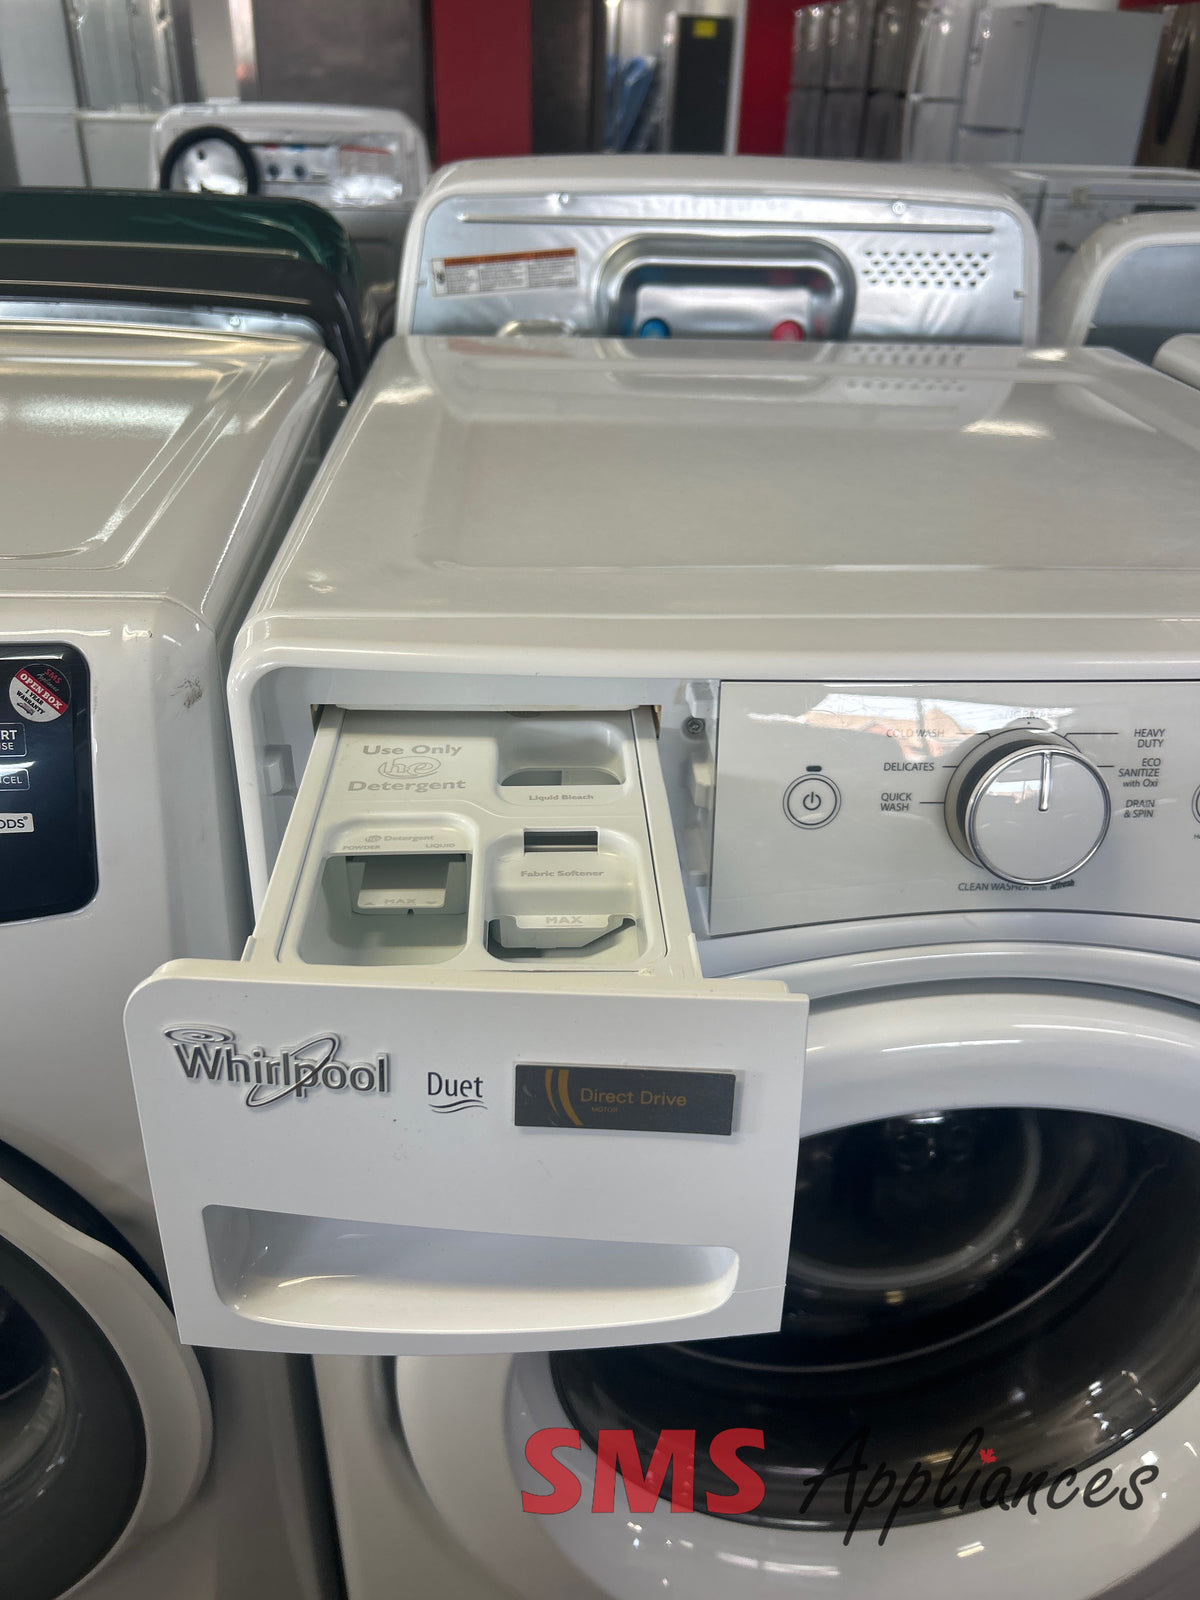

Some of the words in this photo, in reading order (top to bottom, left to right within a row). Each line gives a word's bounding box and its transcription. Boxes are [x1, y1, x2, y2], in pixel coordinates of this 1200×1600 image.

[20, 673, 44, 694] OPEN
[42, 691, 63, 710] BOX
[16, 690, 46, 715] WARRANTY
[30, 693, 44, 706] YEAR
[886, 728, 913, 738] COLD
[917, 728, 945, 738] WASH
[1134, 728, 1165, 738] HEAVY
[0, 742, 15, 751] SE
[1137, 739, 1164, 748] DUTY
[362, 744, 404, 755] Use
[411, 744, 462, 757] Only
[883, 762, 935, 772] DELICATES
[1141, 757, 1162, 767] ECO
[1118, 768, 1160, 778] SANITIZE
[347, 780, 467, 793] Detergent
[1123, 780, 1140, 788] with
[1142, 779, 1159, 788] Oxi
[528, 794, 559, 802] Liquid
[880, 792, 912, 802] QUICK
[880, 803, 909, 812] WASH
[1125, 799, 1155, 809] DRAIN
[1123, 810, 1131, 818] &
[1132, 810, 1154, 818] SPIN
[958, 882, 989, 891] CLEAN
[545, 916, 583, 924] MAX
[172, 1040, 391, 1102] Whirlpool
[427, 1072, 484, 1098] Duet
[580, 1087, 634, 1104] Direct
[640, 1090, 687, 1106] Drive
